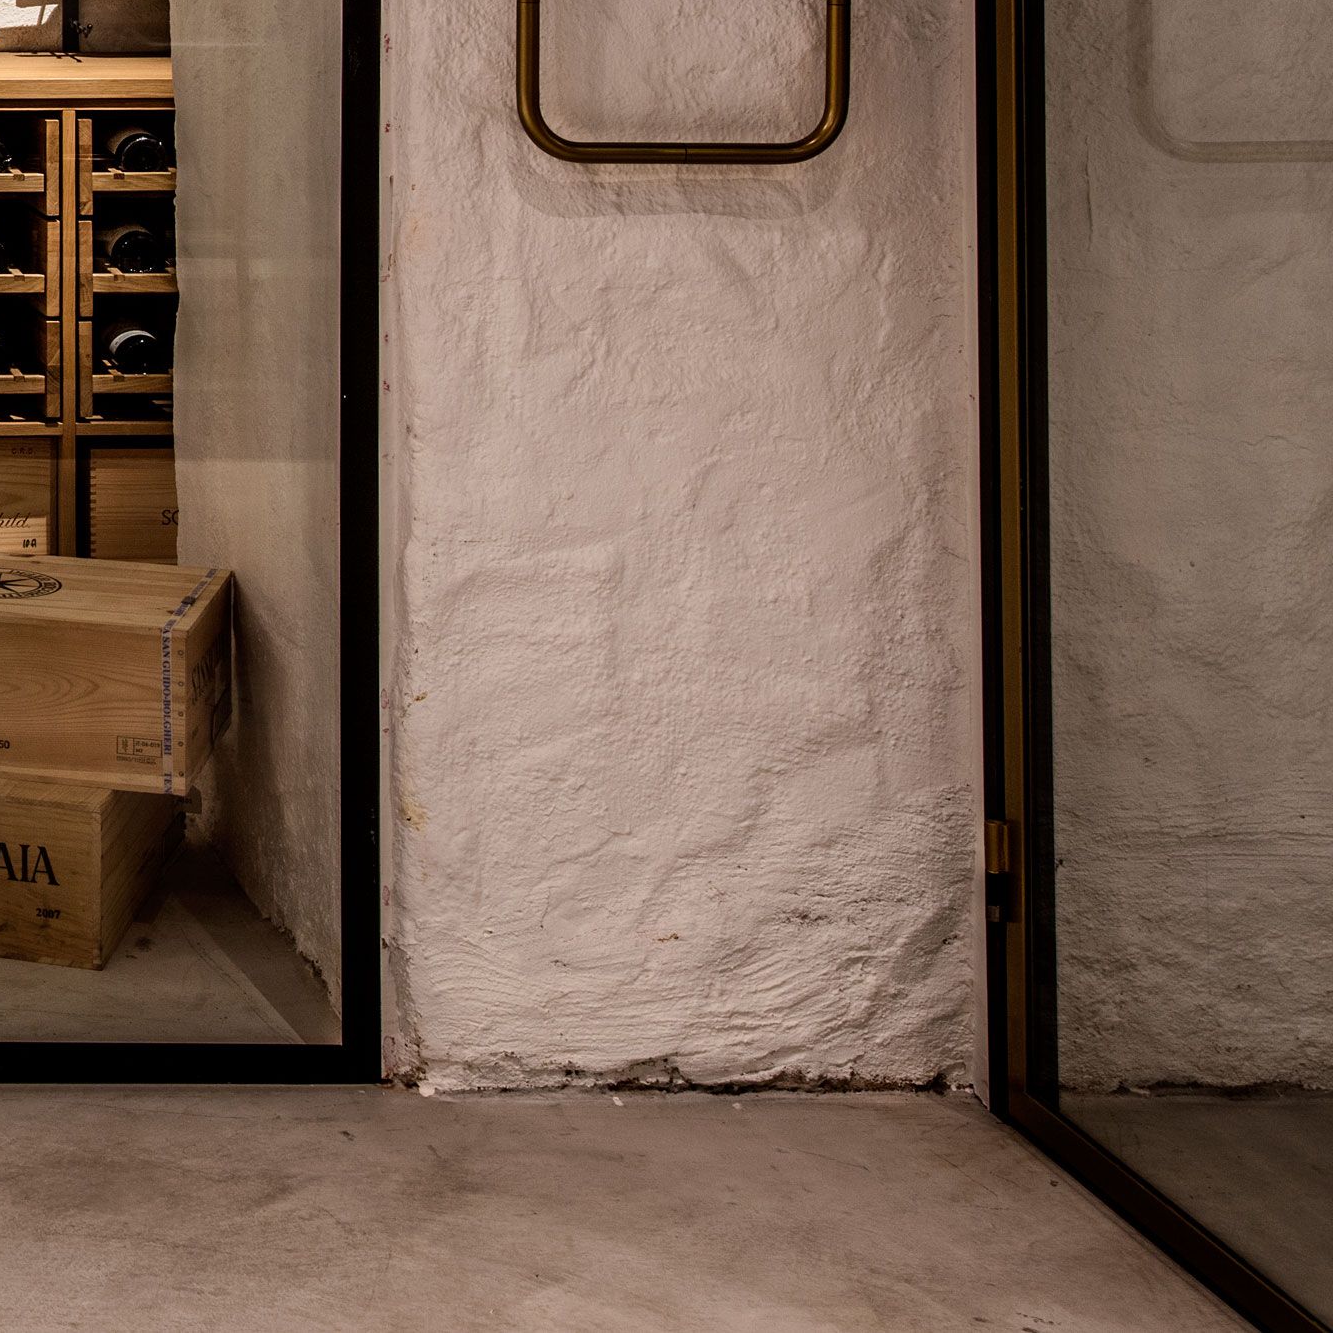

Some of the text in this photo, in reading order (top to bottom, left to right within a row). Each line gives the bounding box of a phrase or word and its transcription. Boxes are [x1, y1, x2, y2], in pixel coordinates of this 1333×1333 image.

[162, 635, 170, 660] SAN
[163, 662, 172, 755] GUIDO-BOLGHERI
[35, 908, 61, 919] 2007
